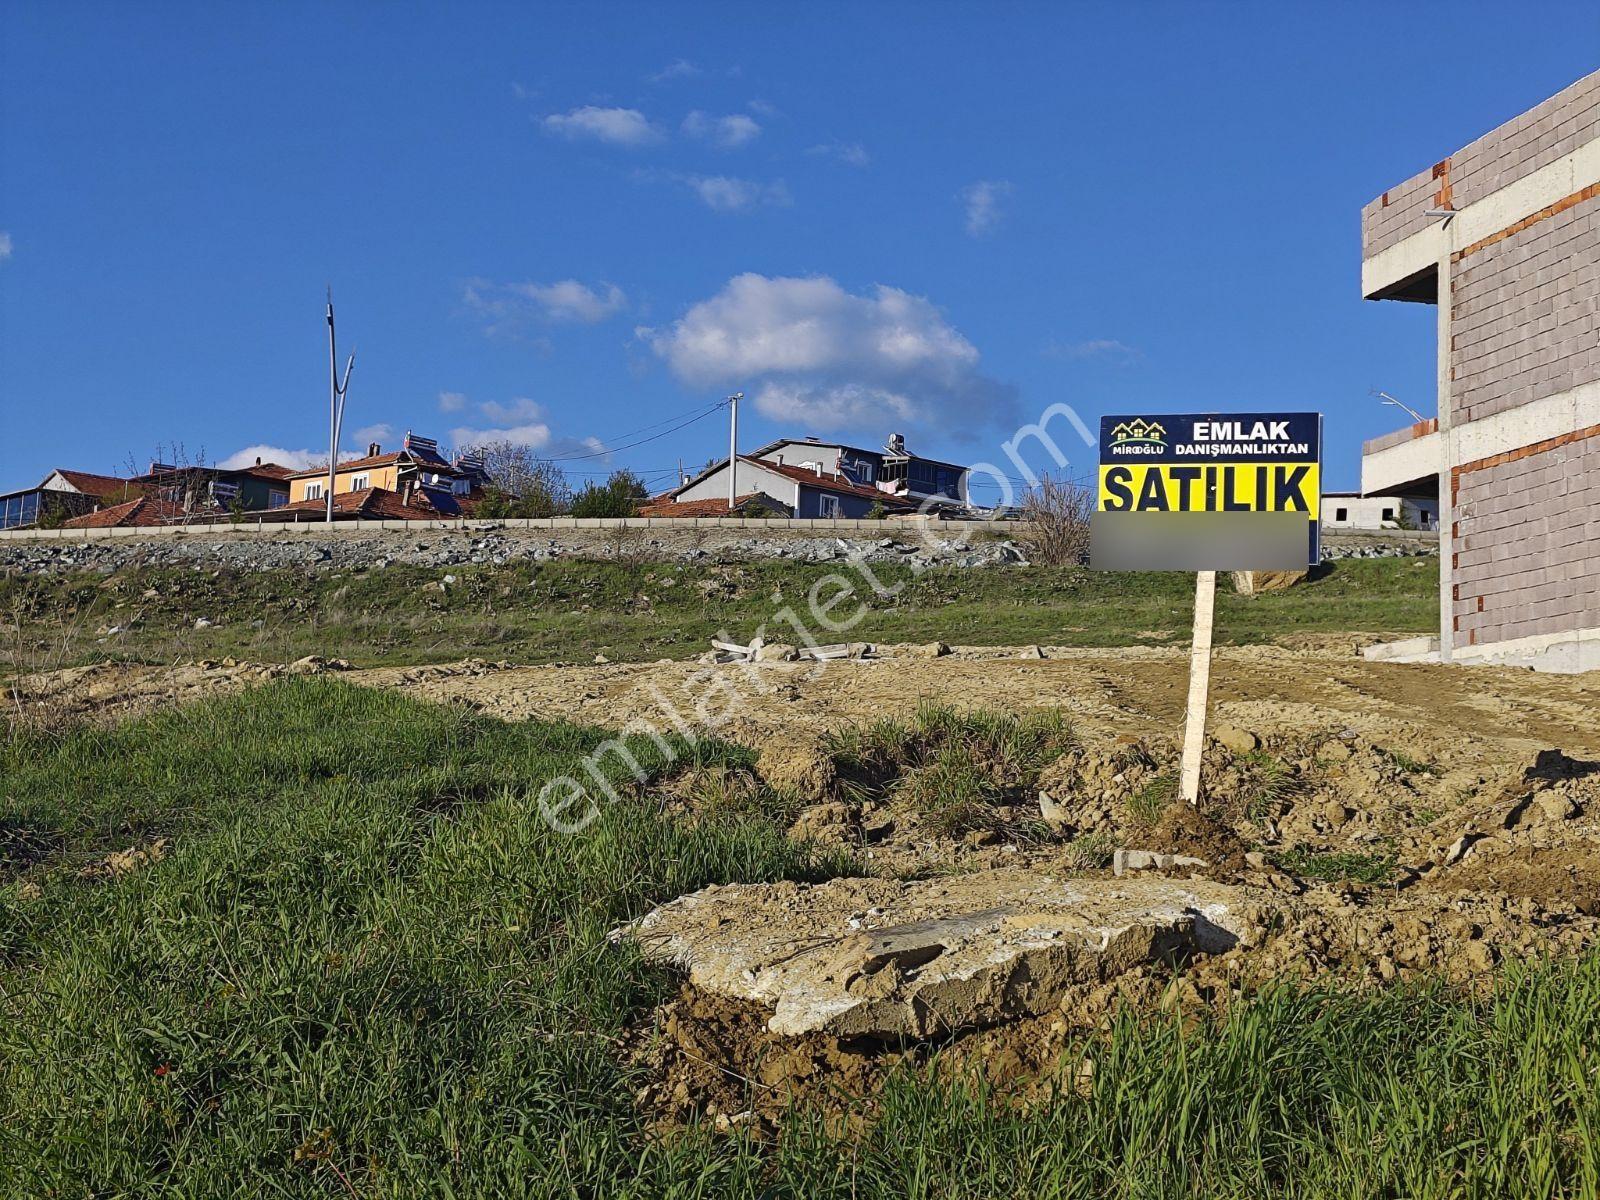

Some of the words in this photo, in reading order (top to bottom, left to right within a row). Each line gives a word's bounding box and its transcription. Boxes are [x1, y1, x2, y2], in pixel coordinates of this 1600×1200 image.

[1193, 421, 1290, 440] EMLAK
[1175, 443, 1308, 457] DANIŞMANLIKTAN
[1103, 466, 1311, 513] SATILIK
